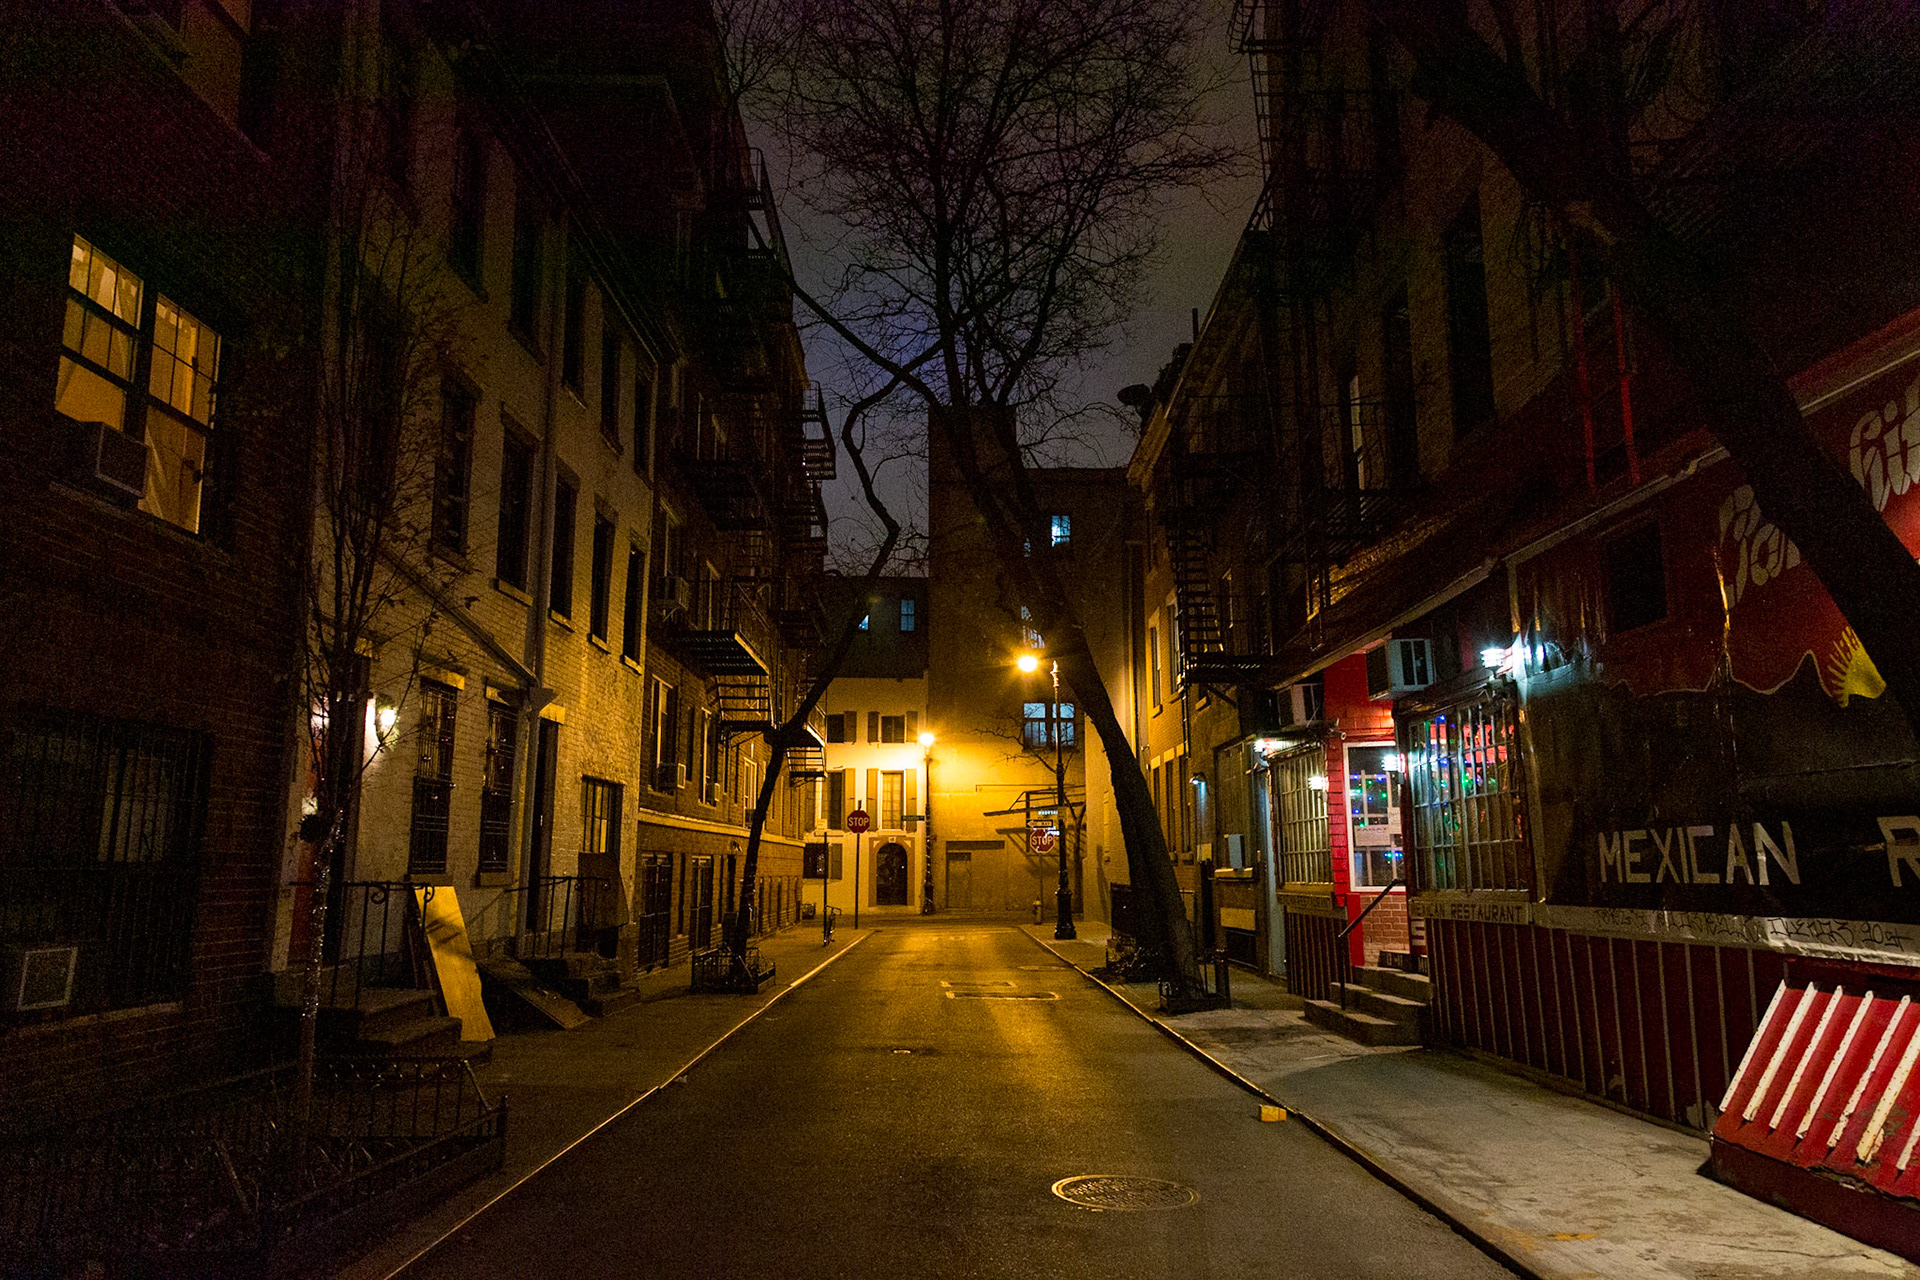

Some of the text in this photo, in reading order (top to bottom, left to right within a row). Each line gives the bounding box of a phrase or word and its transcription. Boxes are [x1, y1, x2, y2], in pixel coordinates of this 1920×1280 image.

[848, 816, 870, 827] STOP
[1031, 835, 1054, 846] STOP
[1598, 820, 1801, 886] MEXICAN
[1450, 902, 1523, 923] RESTAURANT
